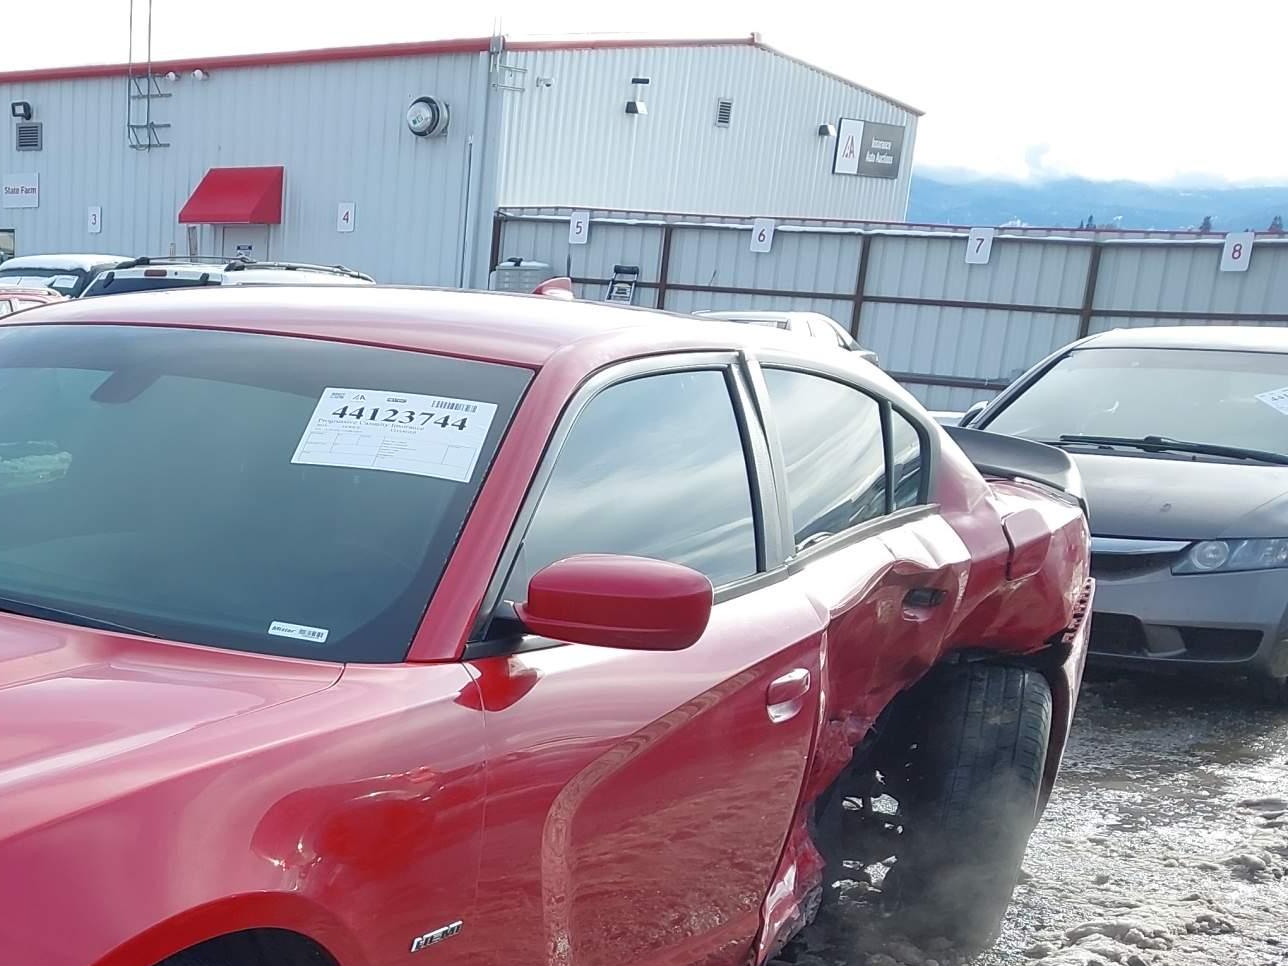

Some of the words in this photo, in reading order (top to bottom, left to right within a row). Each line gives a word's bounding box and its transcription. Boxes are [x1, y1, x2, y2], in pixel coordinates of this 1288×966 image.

[4, 186, 20, 195] State
[21, 185, 37, 195] Farm
[91, 213, 97, 225] 3
[342, 210, 350, 224] 4
[575, 220, 583, 235] 5
[758, 228, 766, 243] 6
[975, 238, 985, 254] 7
[1231, 243, 1243, 260] 8
[332, 405, 468, 431] 44123744
